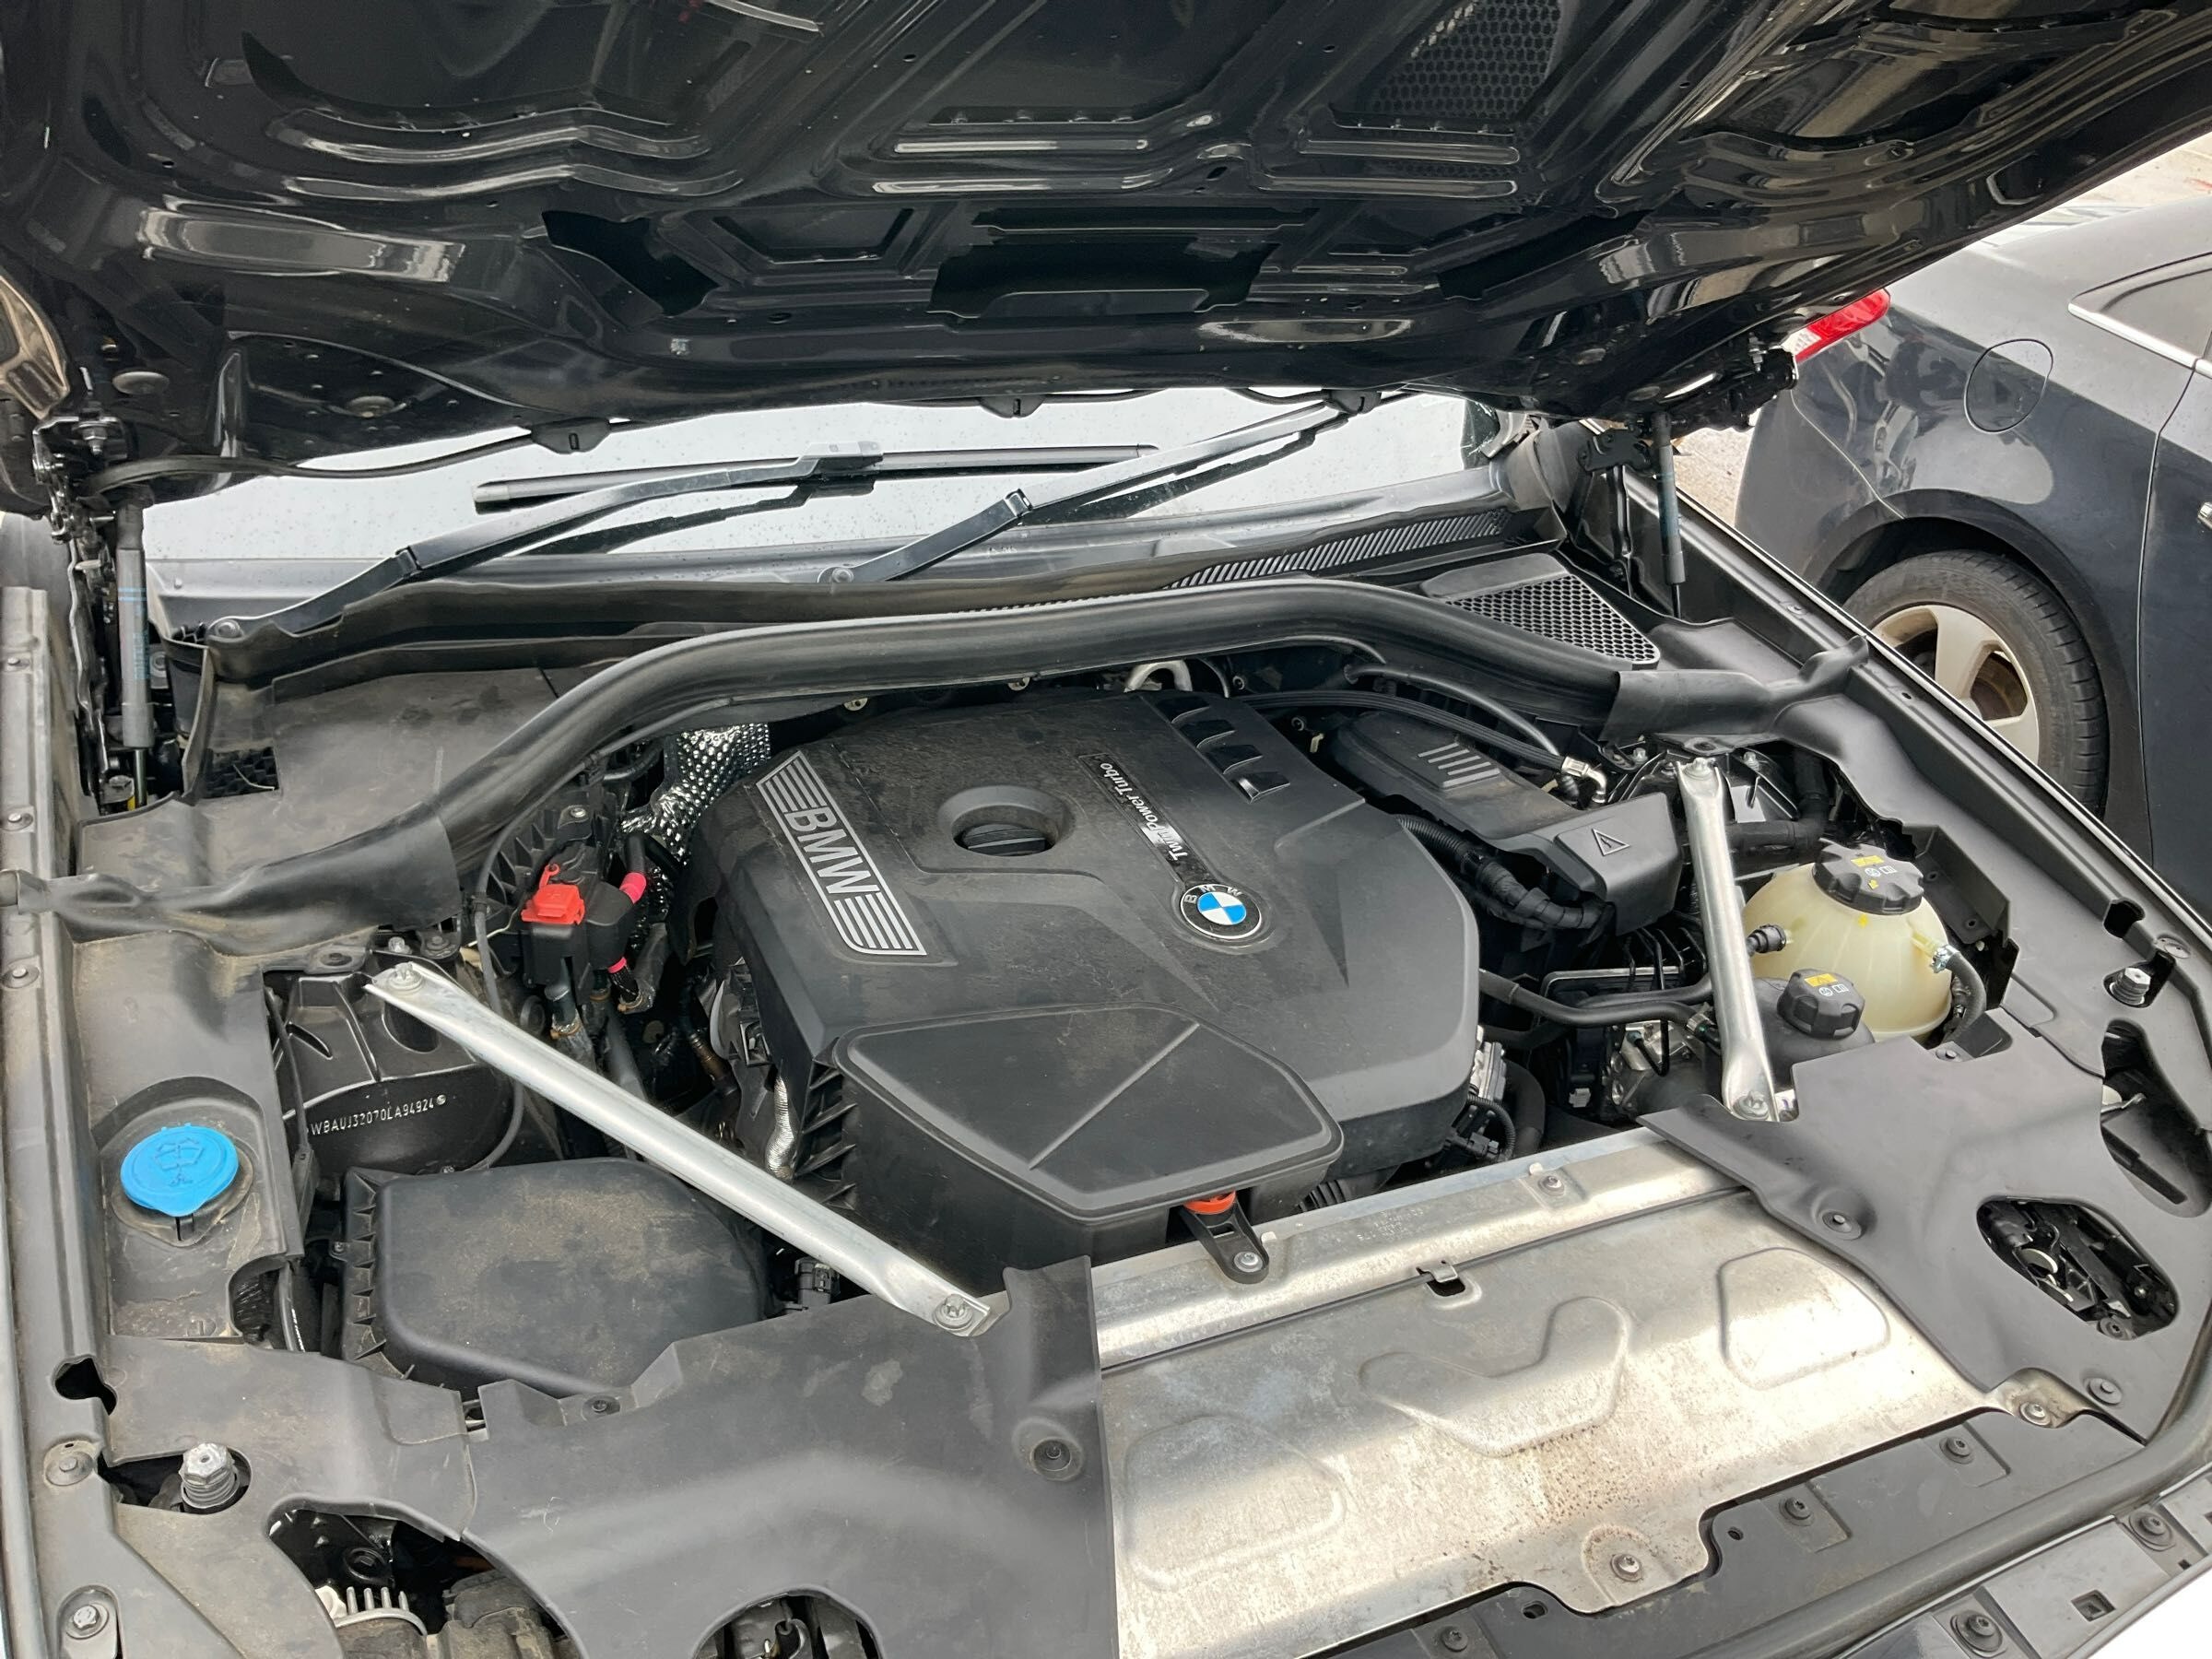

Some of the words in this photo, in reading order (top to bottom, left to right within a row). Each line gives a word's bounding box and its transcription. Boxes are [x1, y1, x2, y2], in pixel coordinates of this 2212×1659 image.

[1100, 762, 1133, 795] Turbo
[783, 806, 881, 894] BMW
[1183, 885, 1242, 904] BMW
